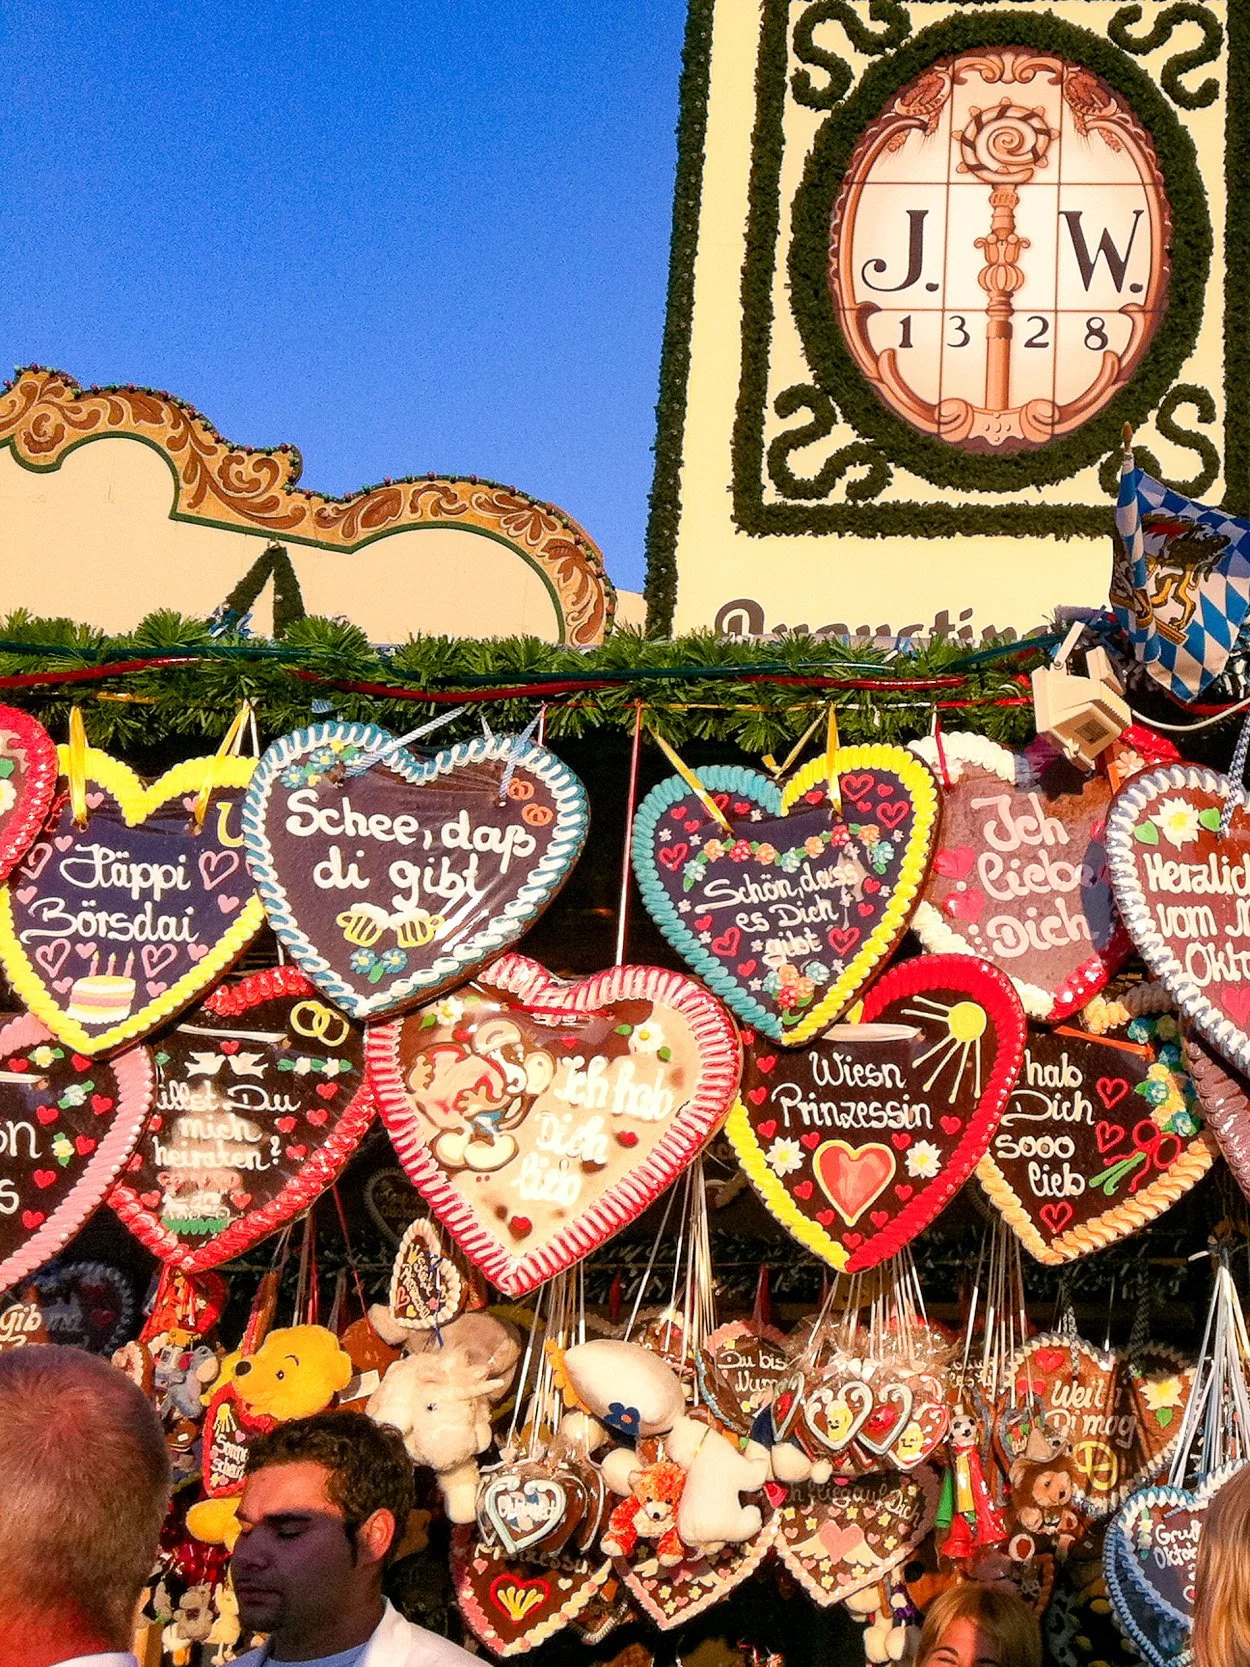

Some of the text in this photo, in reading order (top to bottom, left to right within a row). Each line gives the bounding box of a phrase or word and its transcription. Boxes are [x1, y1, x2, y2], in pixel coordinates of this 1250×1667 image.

[861, 209, 1144, 293] J. W.
[971, 792, 1070, 851] Ich
[59, 844, 190, 900] Häppi
[313, 846, 483, 911] di gibt
[800, 862, 859, 891] dass
[20, 897, 199, 944] Börsdai
[736, 895, 839, 932] es Dich
[986, 897, 1099, 958] Dich
[1157, 903, 1217, 939] vom
[763, 928, 822, 968] gibt
[810, 1051, 907, 1088] Wiesn
[1024, 1049, 1082, 1088] hab
[156, 1080, 301, 1111] illst Du
[611, 1061, 674, 1120] hab
[772, 1083, 933, 1129] Prinzessin
[1000, 1089, 1094, 1126] Dich
[180, 1115, 262, 1142] mich
[534, 1110, 608, 1165] Dich
[1028, 1161, 1085, 1197] lieb
[717, 1350, 787, 1370] Du bis
[1052, 1379, 1104, 1408] Weil
[1082, 1414, 1136, 1449] mog
